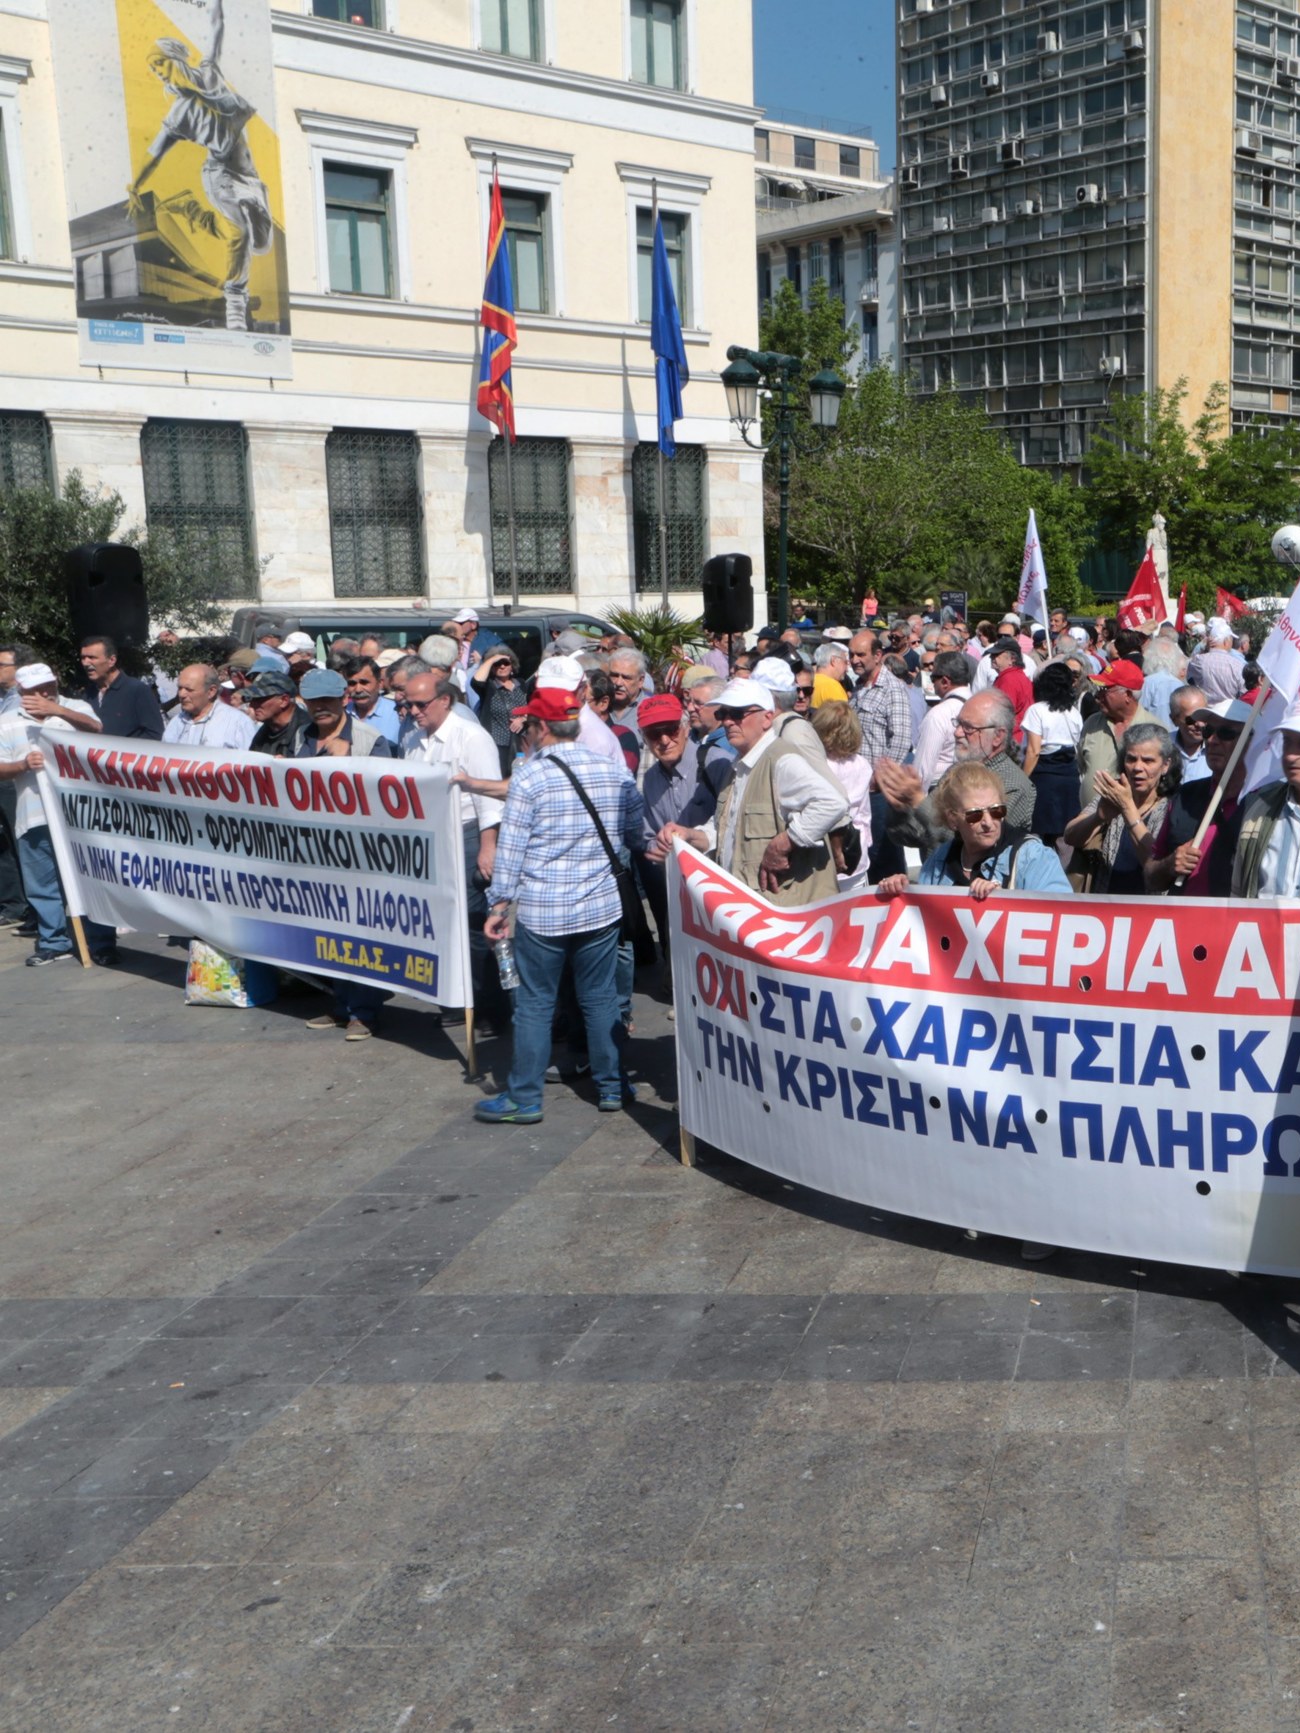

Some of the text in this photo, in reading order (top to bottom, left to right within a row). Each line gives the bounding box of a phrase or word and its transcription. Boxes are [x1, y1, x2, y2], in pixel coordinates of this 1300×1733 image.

[52, 744, 425, 820] ΝΑ ΚΑΤΑΡΓΗΘΟΥΝ ΟΛΟΙ ΟΙ
[61, 793, 194, 846] ΑΝΤΙΑΣΦΑΛΙΣΤΙΚΟΙ
[204, 812, 361, 870] ΦΟΡΟΜΠΗΧΤΙΚΟΙ
[359, 831, 430, 880] ΝΟΜΟΙ
[86, 846, 118, 884] ΜΗΝ
[120, 851, 220, 902] ΕΦΑΡΜΟΣΤΕΙ
[220, 869, 236, 907] Η
[236, 871, 350, 923] ΠΡΟΣΩΠΙΚΗ
[356, 886, 436, 941] ΔΙΑΦΟΡΑ
[315, 935, 389, 974] ΠΑ.Σ.Α.Σ.
[404, 954, 434, 985] ΔΕΗ
[848, 903, 931, 975] ΤΑ
[953, 907, 1187, 996] ΧΕΡΙΑ
[696, 952, 750, 1022] ΟΧΙ
[756, 975, 847, 1050] ΣΤΑ
[864, 997, 1190, 1090] ΧΑΡΑΤΣΙΑ
[698, 1017, 764, 1093] ΤΗΝ
[775, 1050, 929, 1136] ΚΡΙΣΗ
[947, 1089, 1038, 1154] ΝΑ
